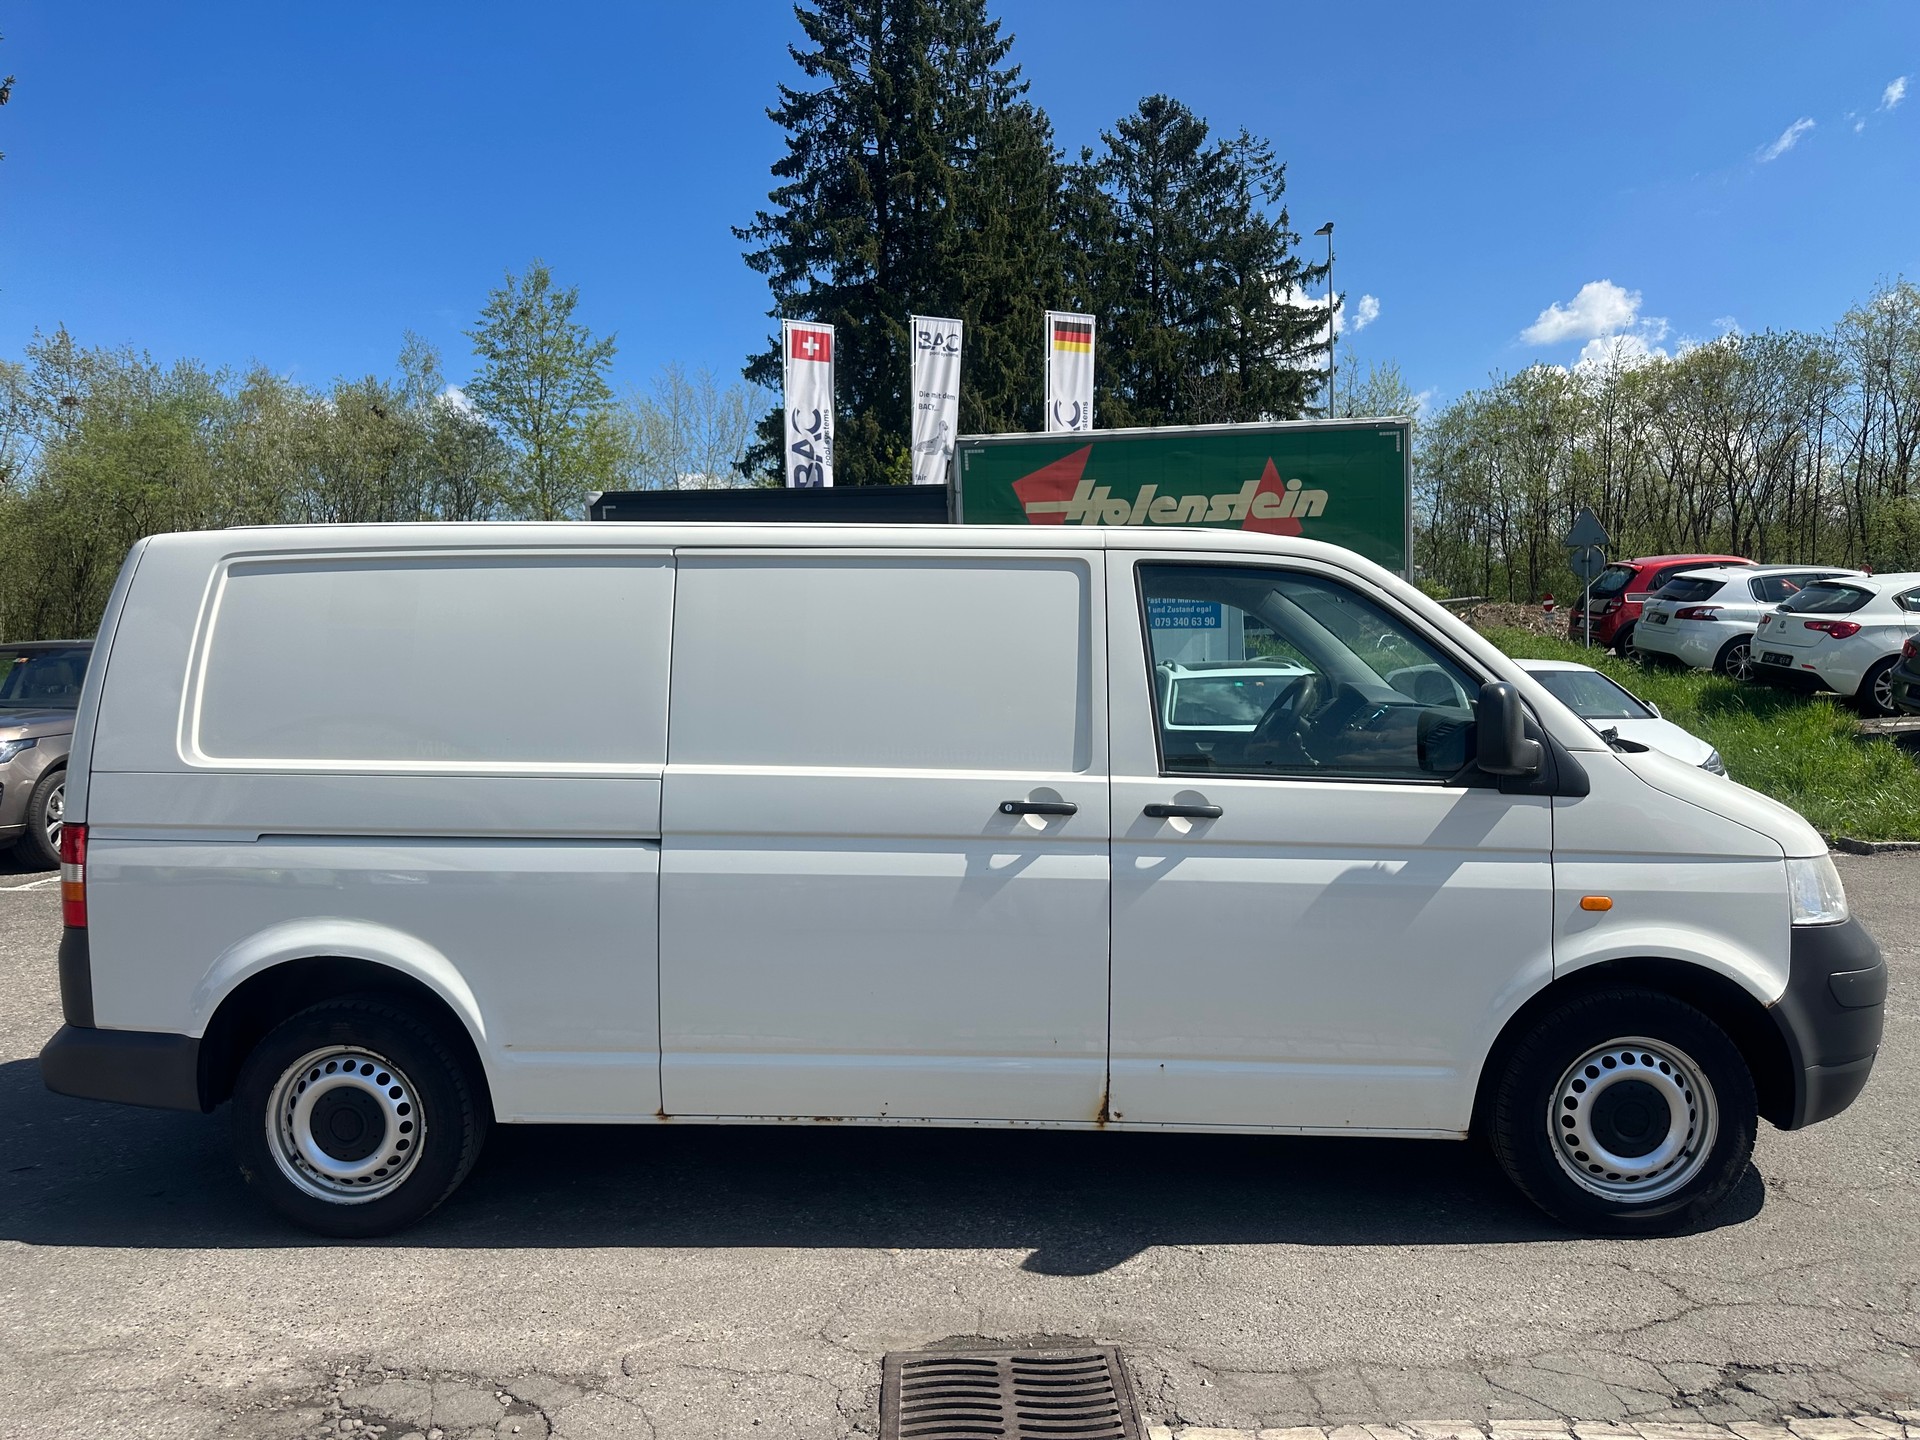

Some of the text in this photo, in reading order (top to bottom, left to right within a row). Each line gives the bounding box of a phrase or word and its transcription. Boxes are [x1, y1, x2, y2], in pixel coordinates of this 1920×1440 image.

[919, 331, 959, 352] BAC
[918, 390, 930, 398] Die
[942, 392, 956, 400] dem
[791, 407, 824, 488] BAC
[823, 409, 832, 467] pool systems
[1026, 478, 1329, 526] Holenstein
[1152, 605, 1166, 613] und
[1167, 605, 1195, 613] Zustand
[1196, 605, 1212, 614] egal
[1155, 616, 1215, 627] 079 340 63 90
